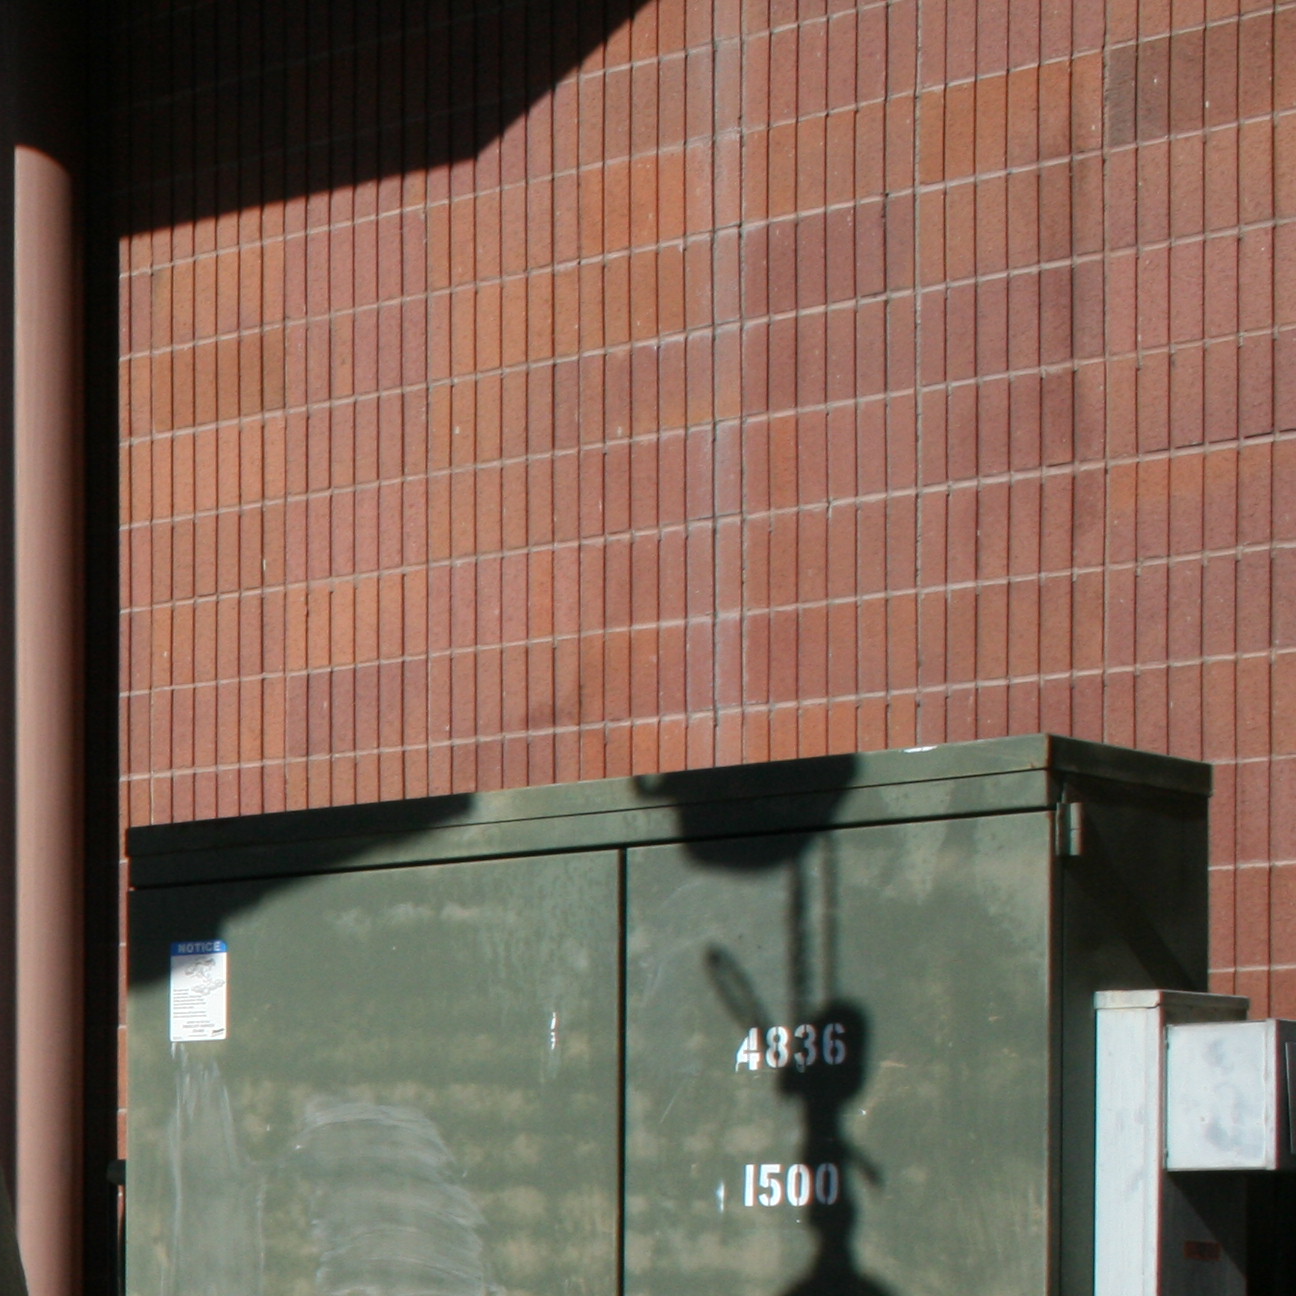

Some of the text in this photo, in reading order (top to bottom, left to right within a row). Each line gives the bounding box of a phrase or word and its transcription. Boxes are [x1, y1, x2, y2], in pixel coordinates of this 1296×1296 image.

[178, 941, 221, 953] NOTICE
[735, 1023, 846, 1071] 4836
[744, 1162, 839, 1207] 1500
